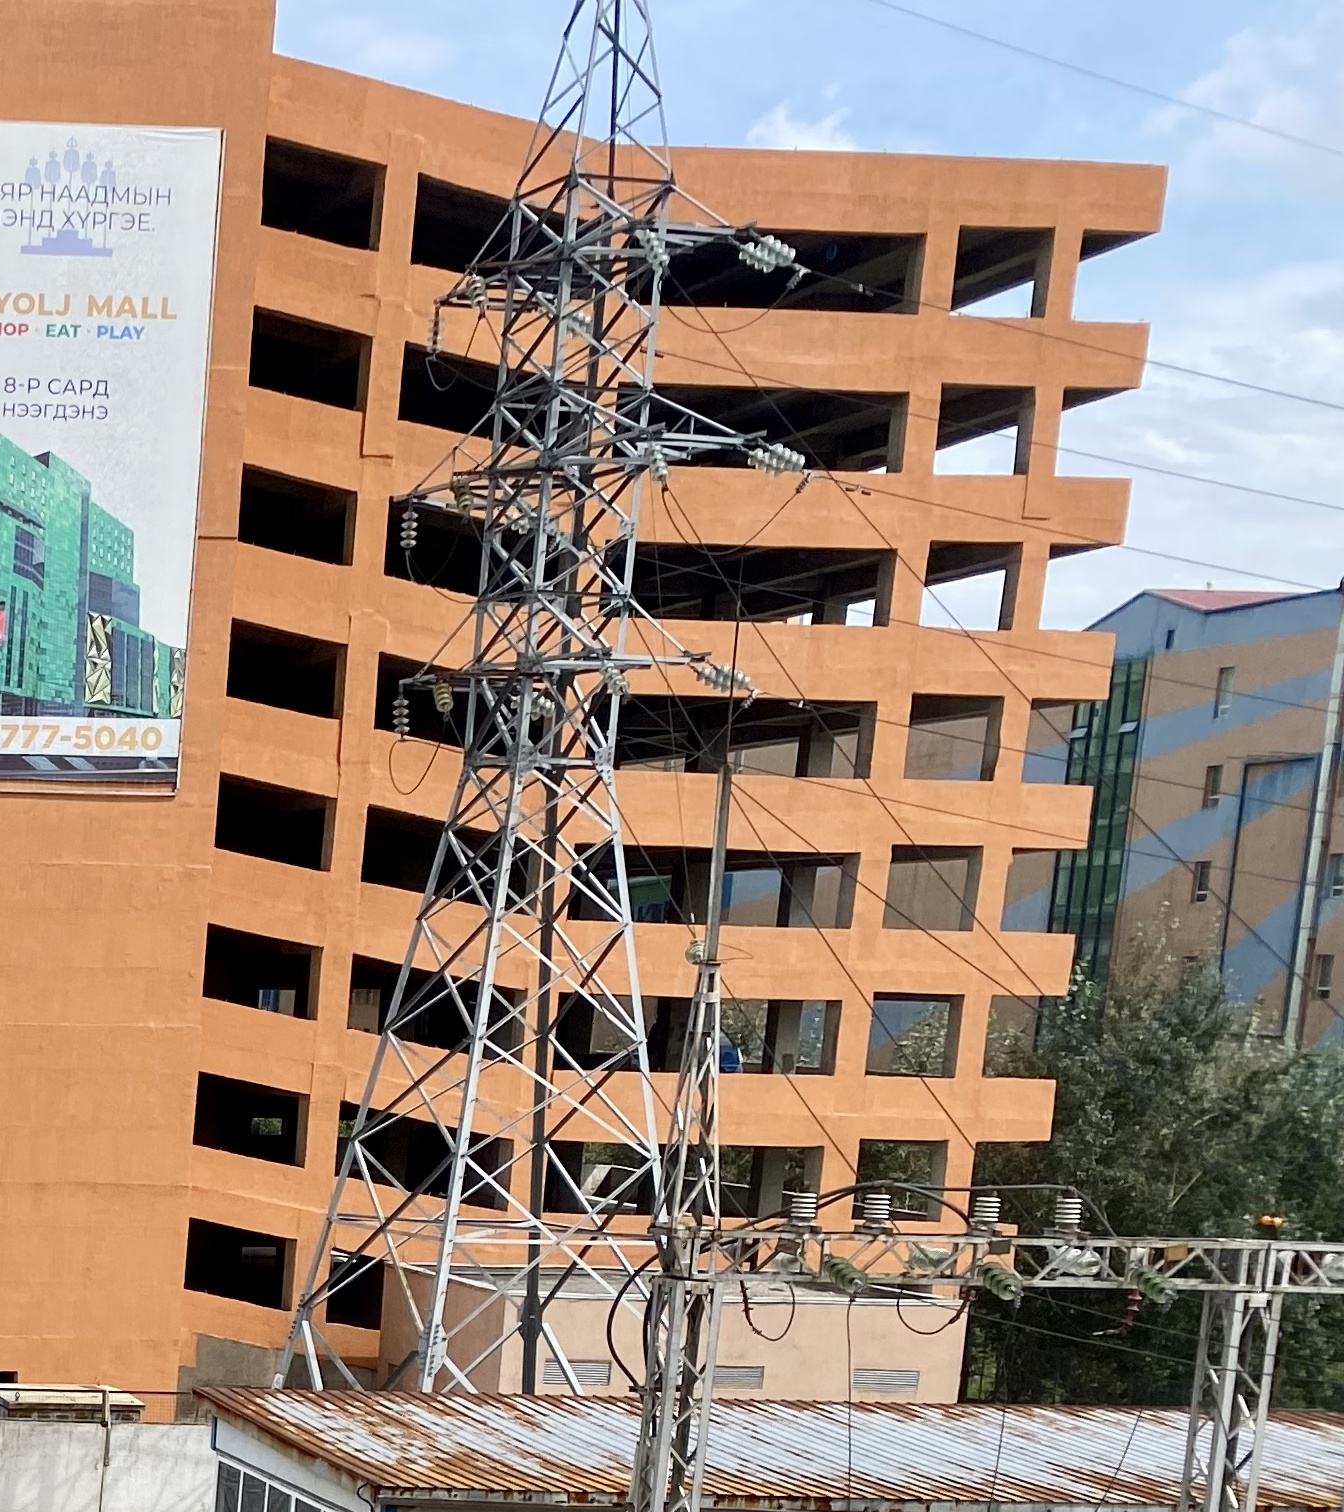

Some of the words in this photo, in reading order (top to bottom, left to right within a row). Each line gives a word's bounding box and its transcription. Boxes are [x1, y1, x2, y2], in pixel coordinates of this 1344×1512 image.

[40, 184, 172, 207] НААДМЫН
[87, 294, 178, 320] MALL
[45, 323, 82, 339] EAT
[96, 325, 145, 341] PLAY
[3, 376, 41, 394] 8-Р
[47, 378, 110, 400] САРД
[2, 402, 108, 422] НЭЭГДЭНЭ
